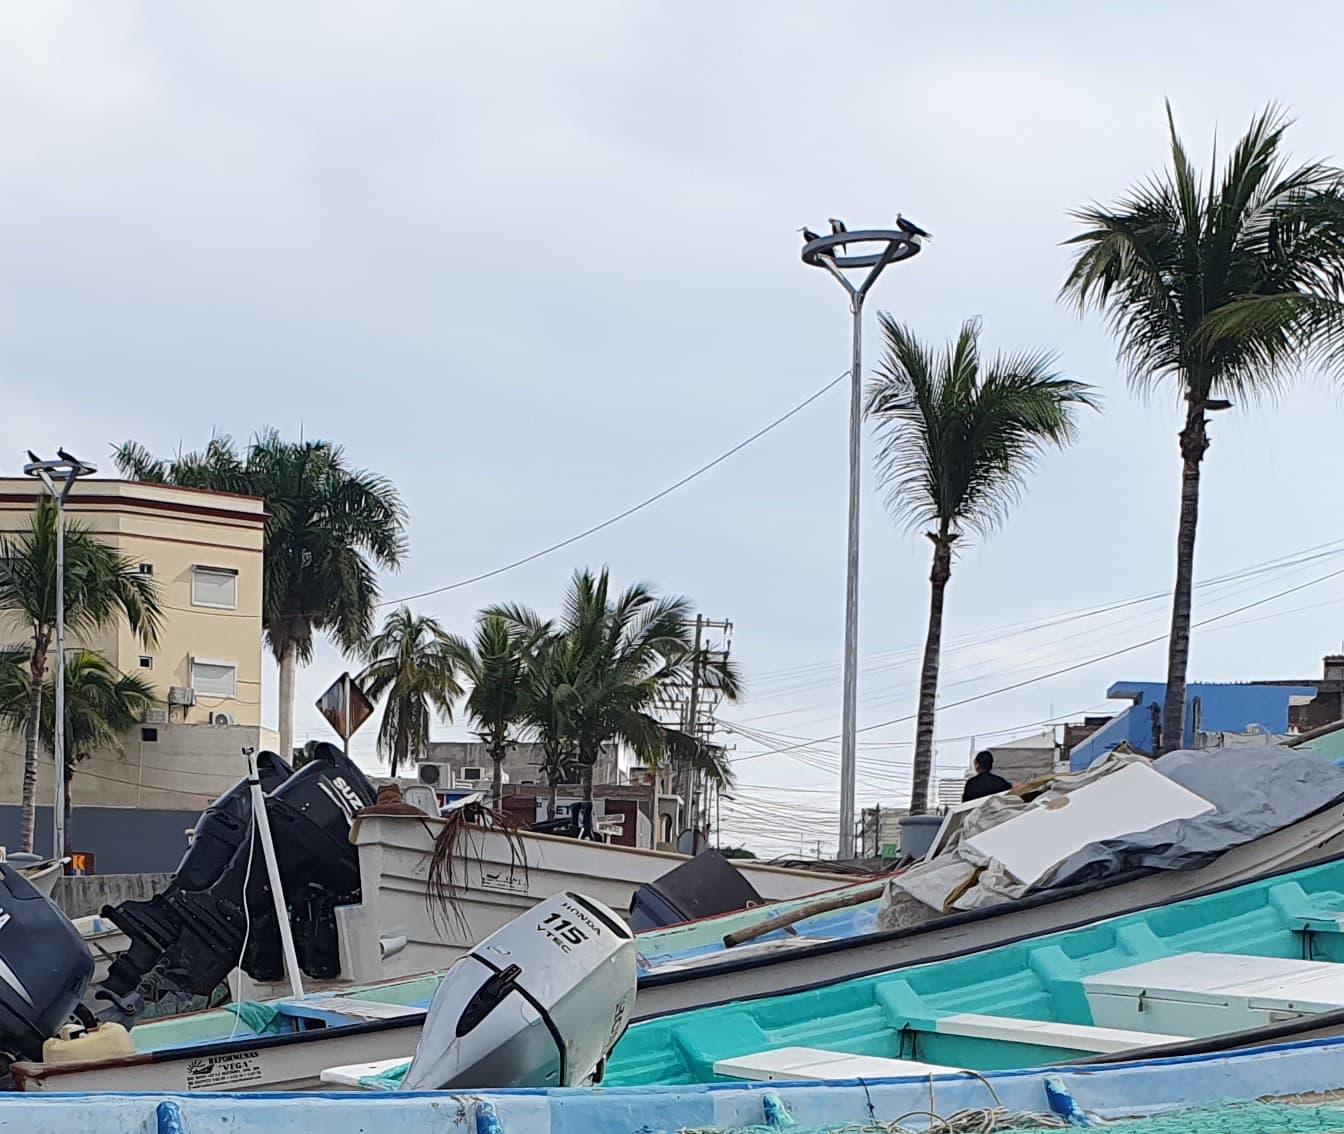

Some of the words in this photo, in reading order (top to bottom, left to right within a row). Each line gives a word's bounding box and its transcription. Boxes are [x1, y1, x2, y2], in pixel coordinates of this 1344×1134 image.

[543, 912, 589, 945] 115
[560, 902, 601, 936] HONDA
[537, 924, 572, 955] VTEC
